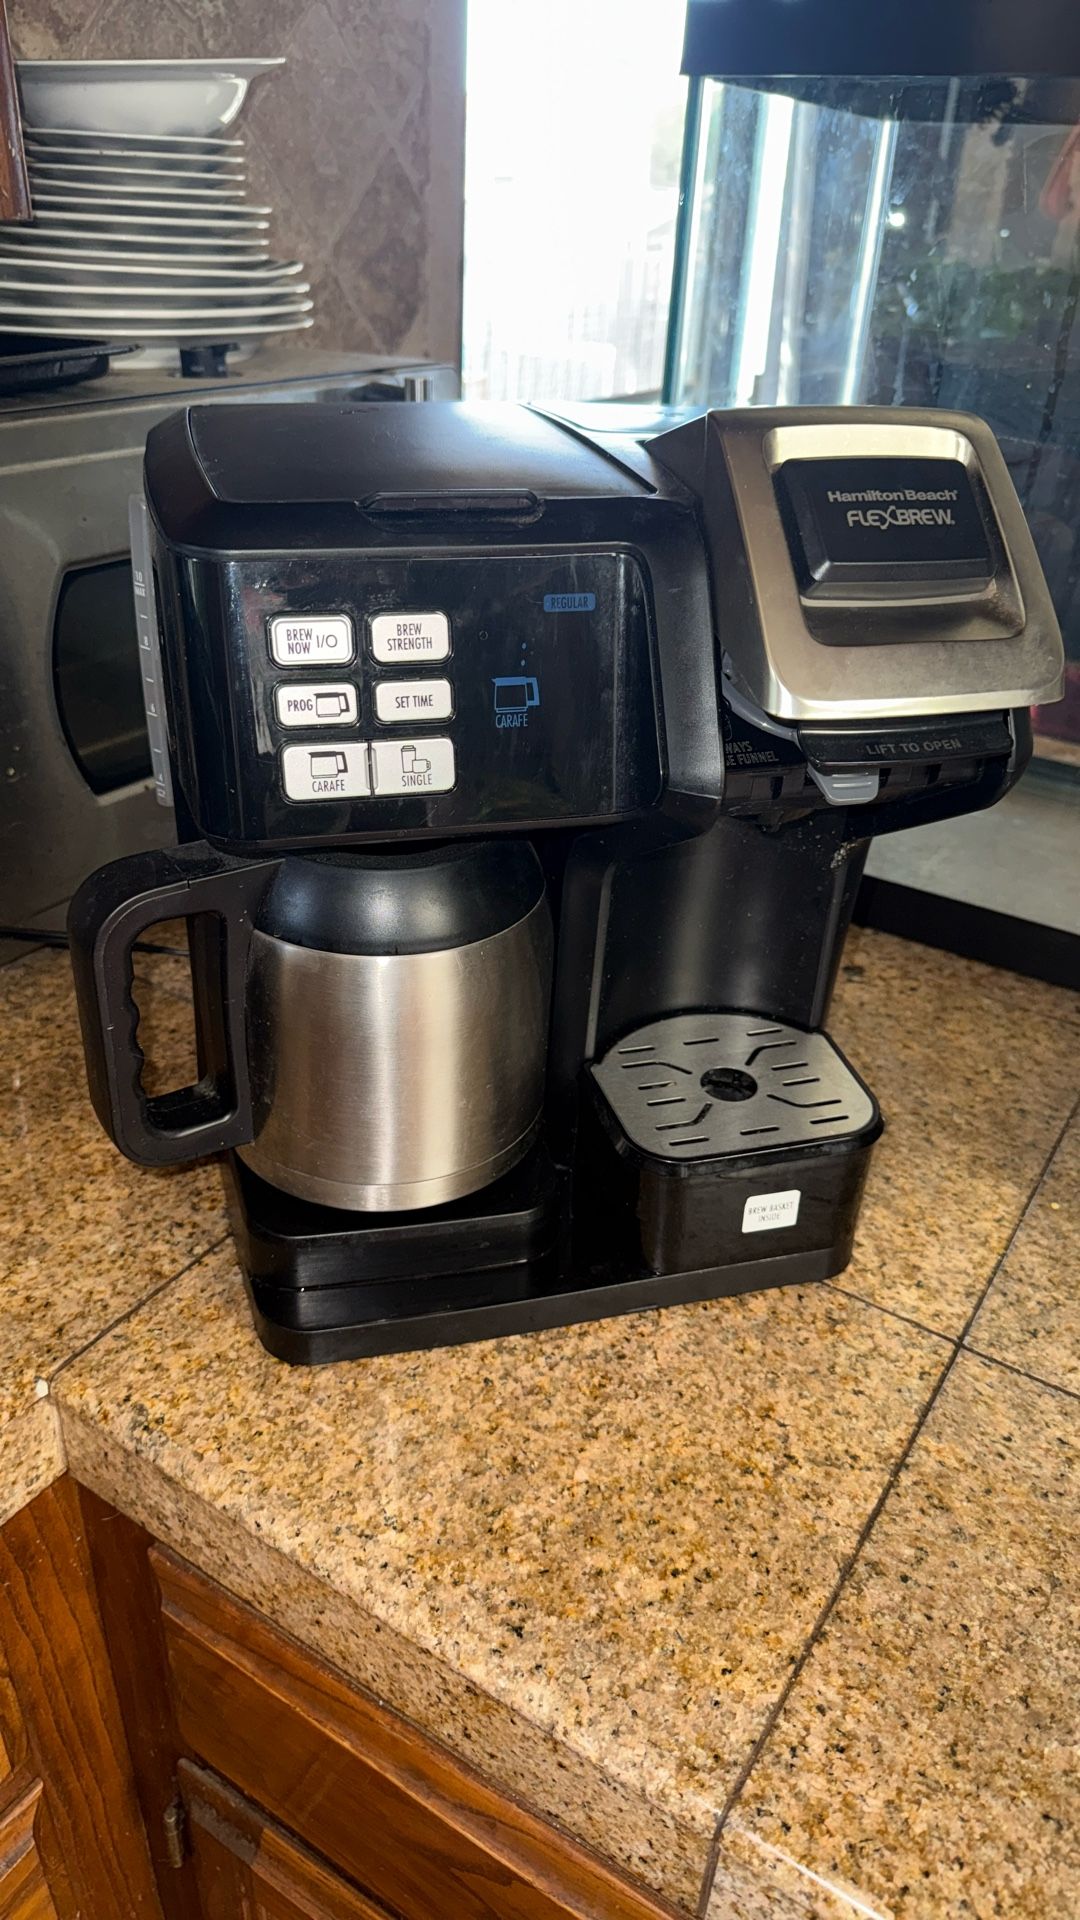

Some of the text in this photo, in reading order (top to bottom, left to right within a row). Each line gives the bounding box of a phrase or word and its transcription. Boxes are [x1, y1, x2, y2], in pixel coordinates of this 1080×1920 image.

[827, 490, 904, 502] Hamilton
[550, 596, 589, 609] REGULAR
[286, 628, 313, 641] BREW
[396, 623, 422, 636] BREW
[288, 642, 311, 655] NOW
[387, 637, 433, 651] STRENGTH
[287, 698, 313, 712] PROG
[395, 694, 434, 709] SET TIME
[495, 713, 529, 729] CARAFE
[866, 738, 962, 755] LIFT TO OPEN
[312, 779, 346, 793] CARAFE
[401, 774, 433, 787] SINGLE
